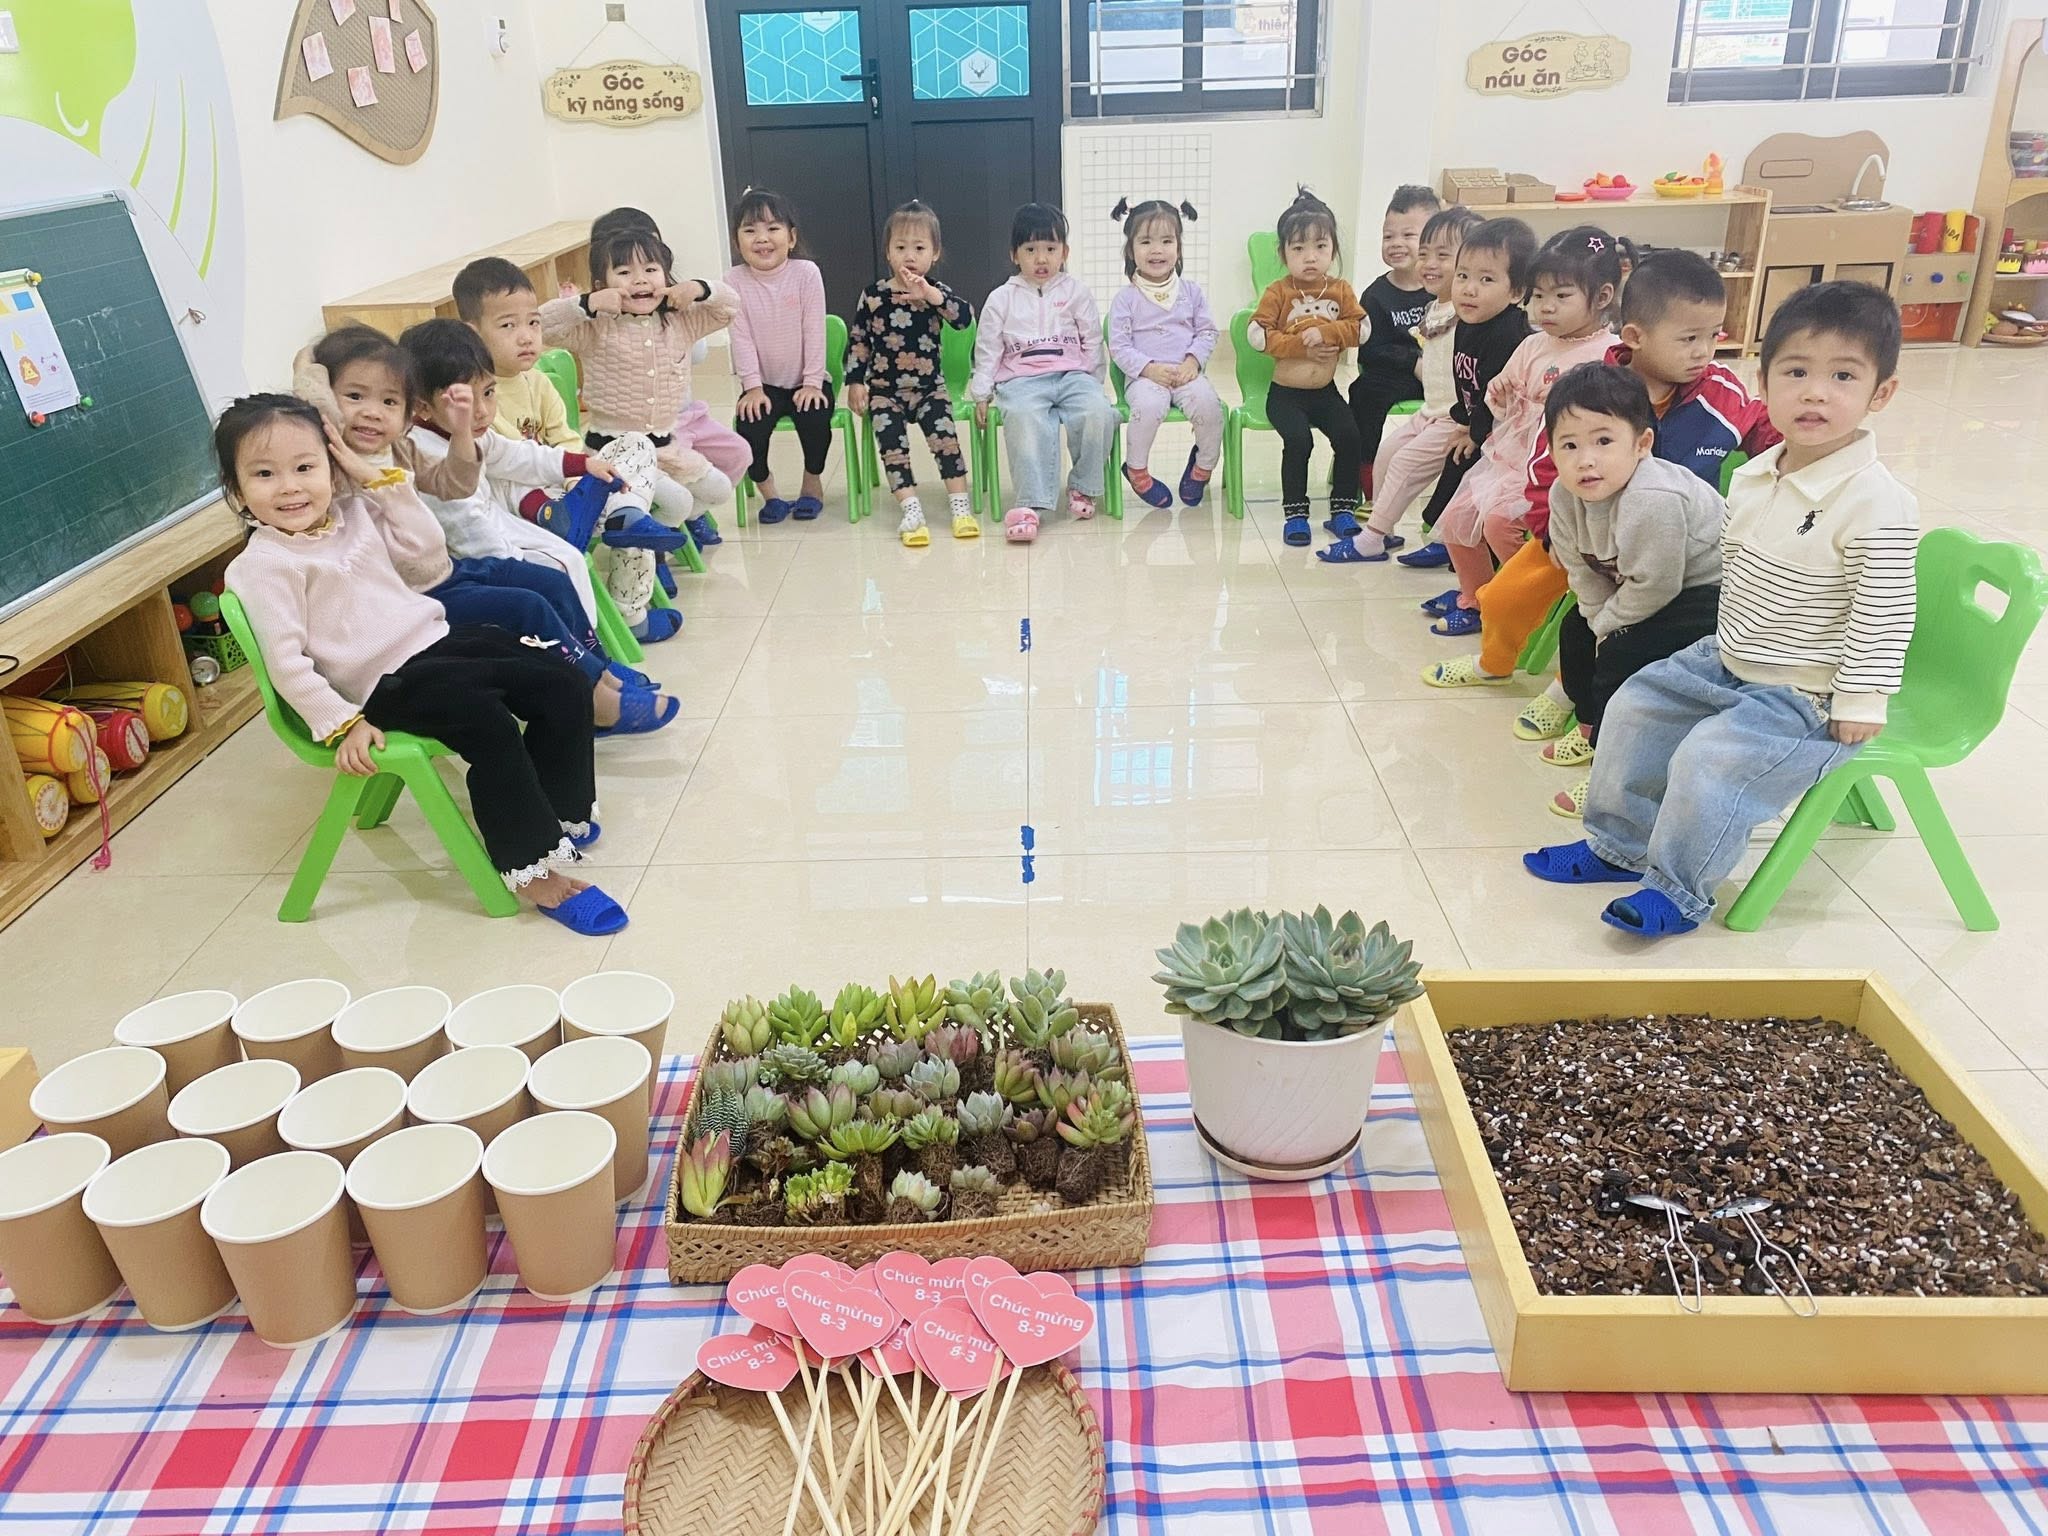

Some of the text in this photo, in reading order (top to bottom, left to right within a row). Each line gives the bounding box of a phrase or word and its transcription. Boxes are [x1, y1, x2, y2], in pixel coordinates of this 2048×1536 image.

[1502, 44, 1547, 63] Góc
[603, 72, 644, 91] Góc
[1485, 67, 1560, 88] nấu ăn
[567, 90, 684, 114] kỹ năng sống
[882, 1267, 964, 1289] Chúc mừn
[971, 1273, 992, 1288] Ch
[736, 1284, 779, 1303] Chúc
[915, 1288, 941, 1303] 8-3
[791, 1285, 832, 1310] Chúc
[835, 1303, 883, 1328] mừng
[989, 1293, 1084, 1332] Chúc mừng
[820, 1312, 847, 1331] 8-3
[1017, 1319, 1046, 1338] 8-3
[923, 1321, 966, 1343] Chúc
[706, 1348, 751, 1369] Chúc
[747, 1351, 776, 1370] 8-3
[949, 1345, 977, 1364] 8-3
